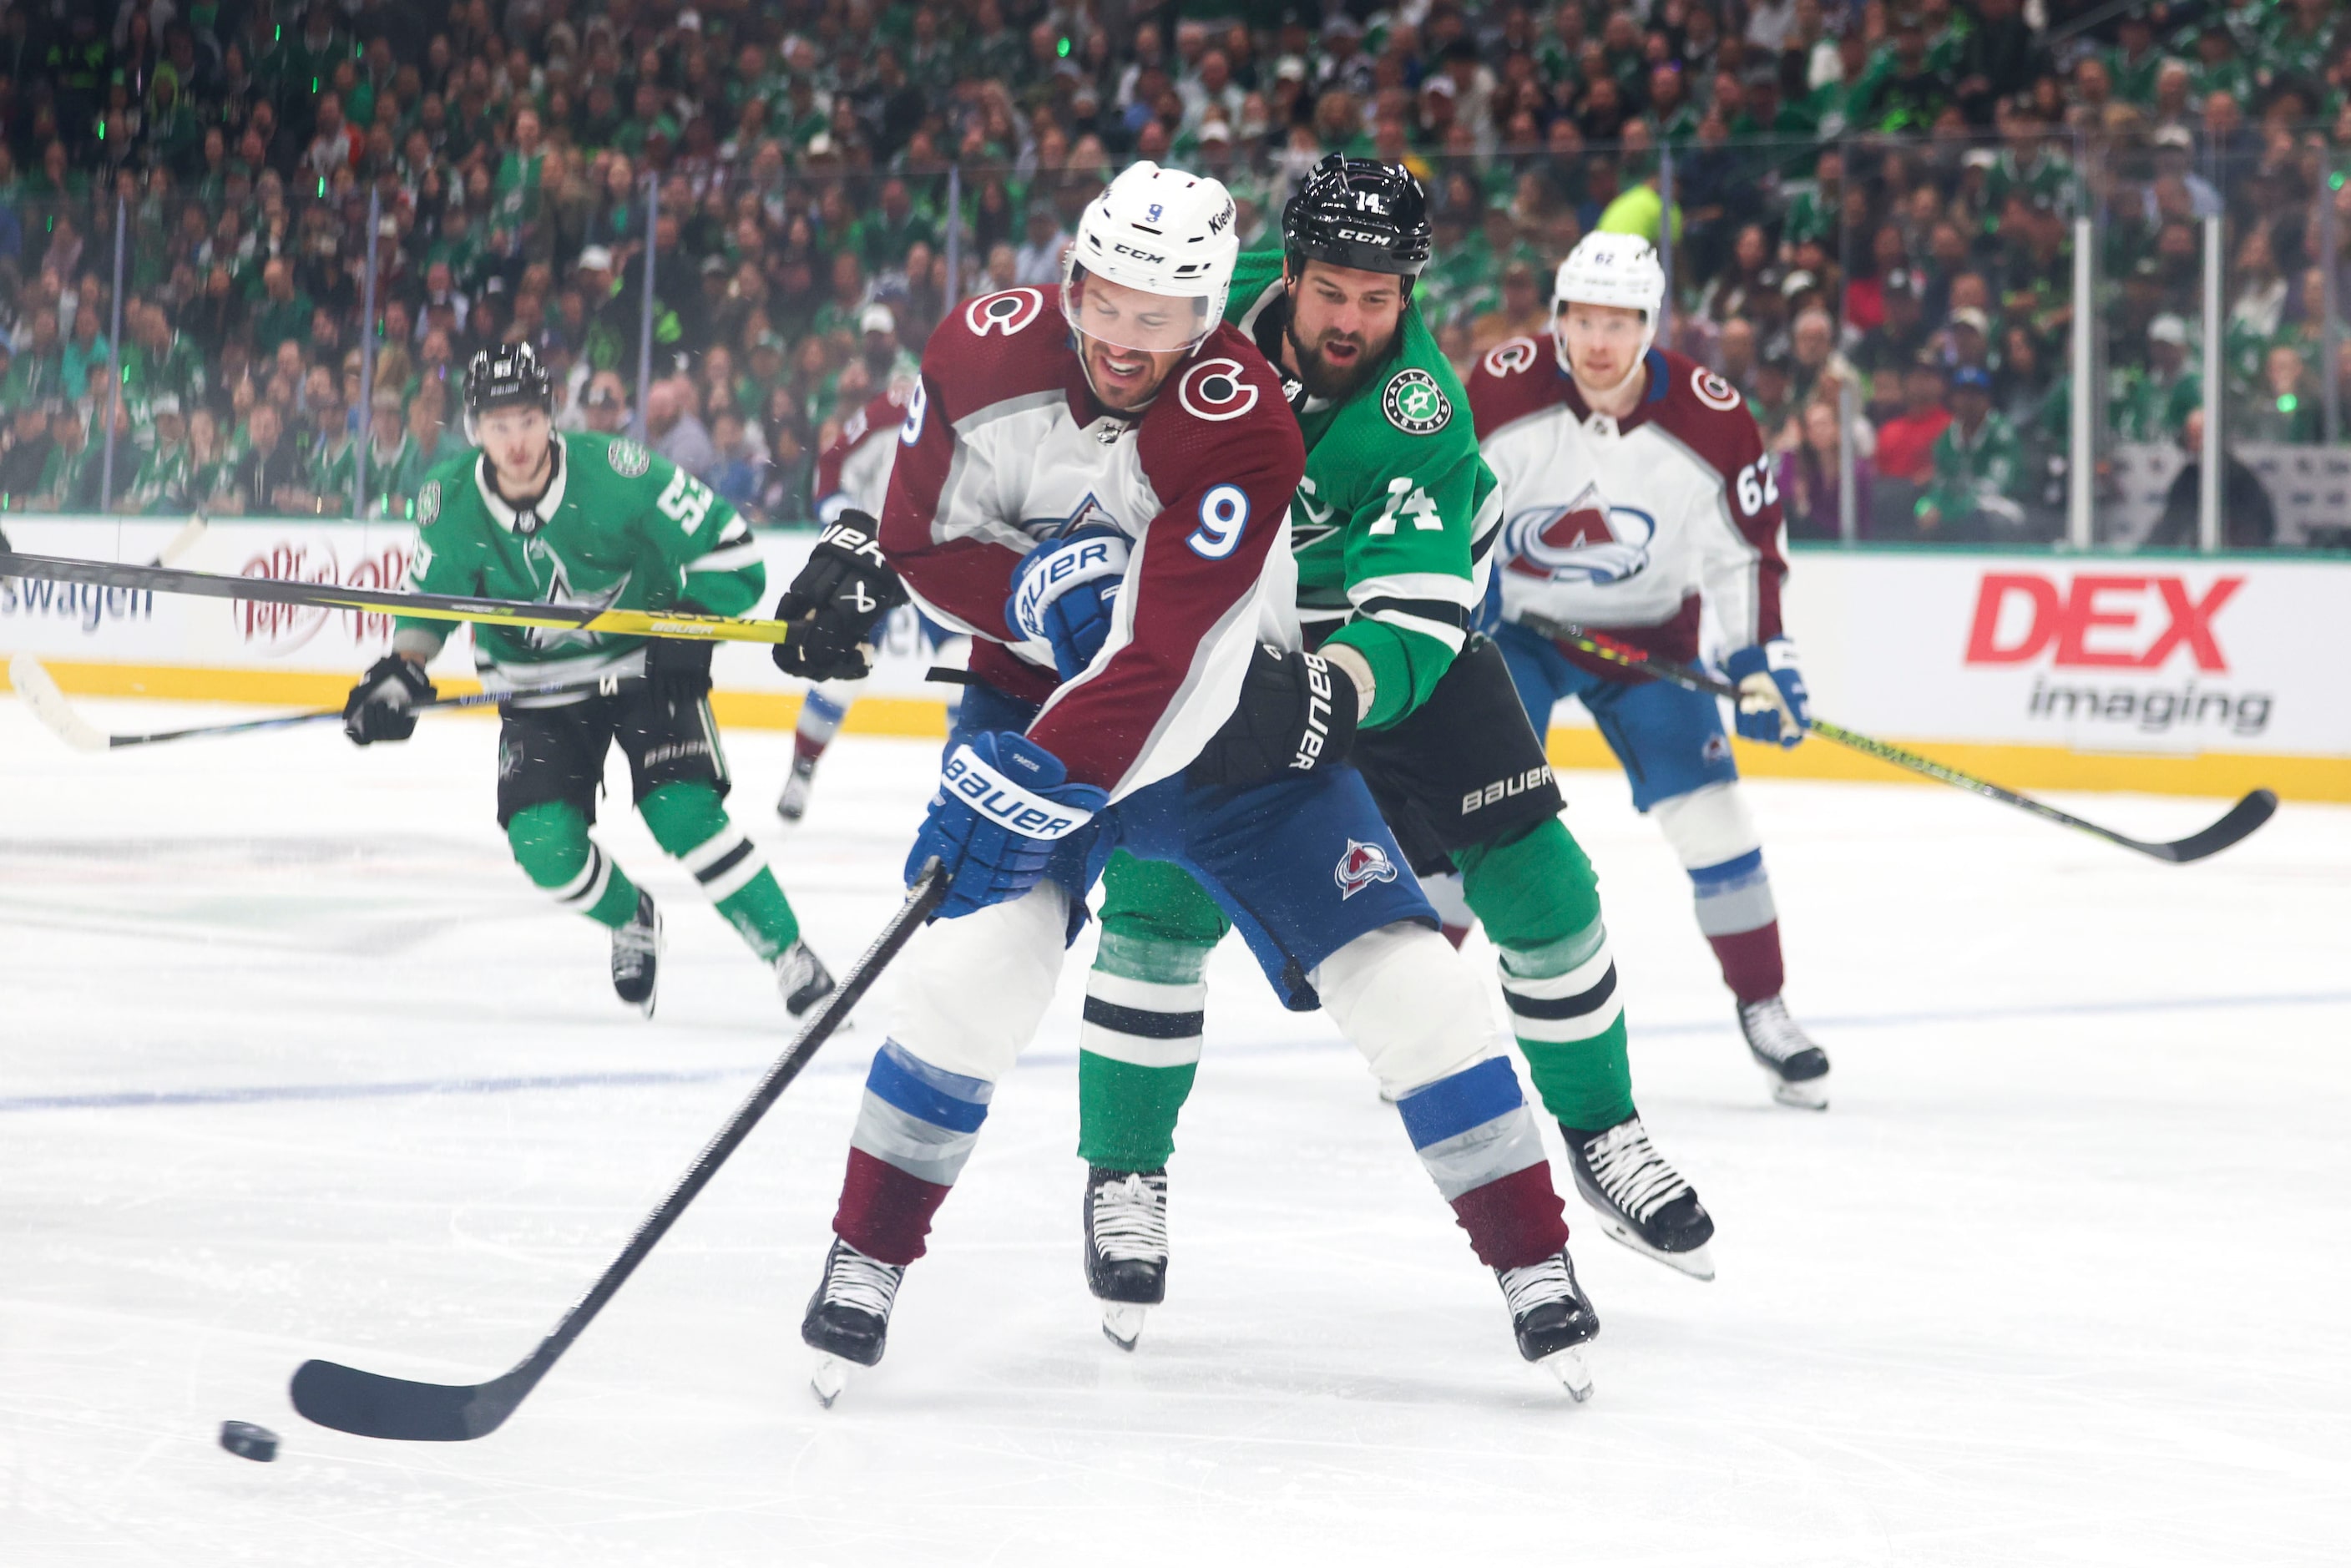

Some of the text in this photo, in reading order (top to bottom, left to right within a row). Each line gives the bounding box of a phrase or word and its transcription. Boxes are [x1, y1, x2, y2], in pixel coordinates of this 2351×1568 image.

[1145, 204, 1164, 223] 9
[1356, 190, 1380, 215] 14
[1114, 243, 1165, 264] CCM
[1337, 228, 1391, 246] CCM
[1400, 404, 1449, 430] STARS
[656, 464, 714, 537] 53
[1368, 477, 1443, 536] 14
[1736, 452, 1779, 517] 62
[1185, 482, 1251, 560] 9
[1965, 573, 2246, 674] DEX
[1288, 651, 1332, 771] BAUER
[2027, 674, 2273, 736] imaging
[944, 758, 1073, 836] BAUER
[1461, 763, 1554, 816] BAUER
